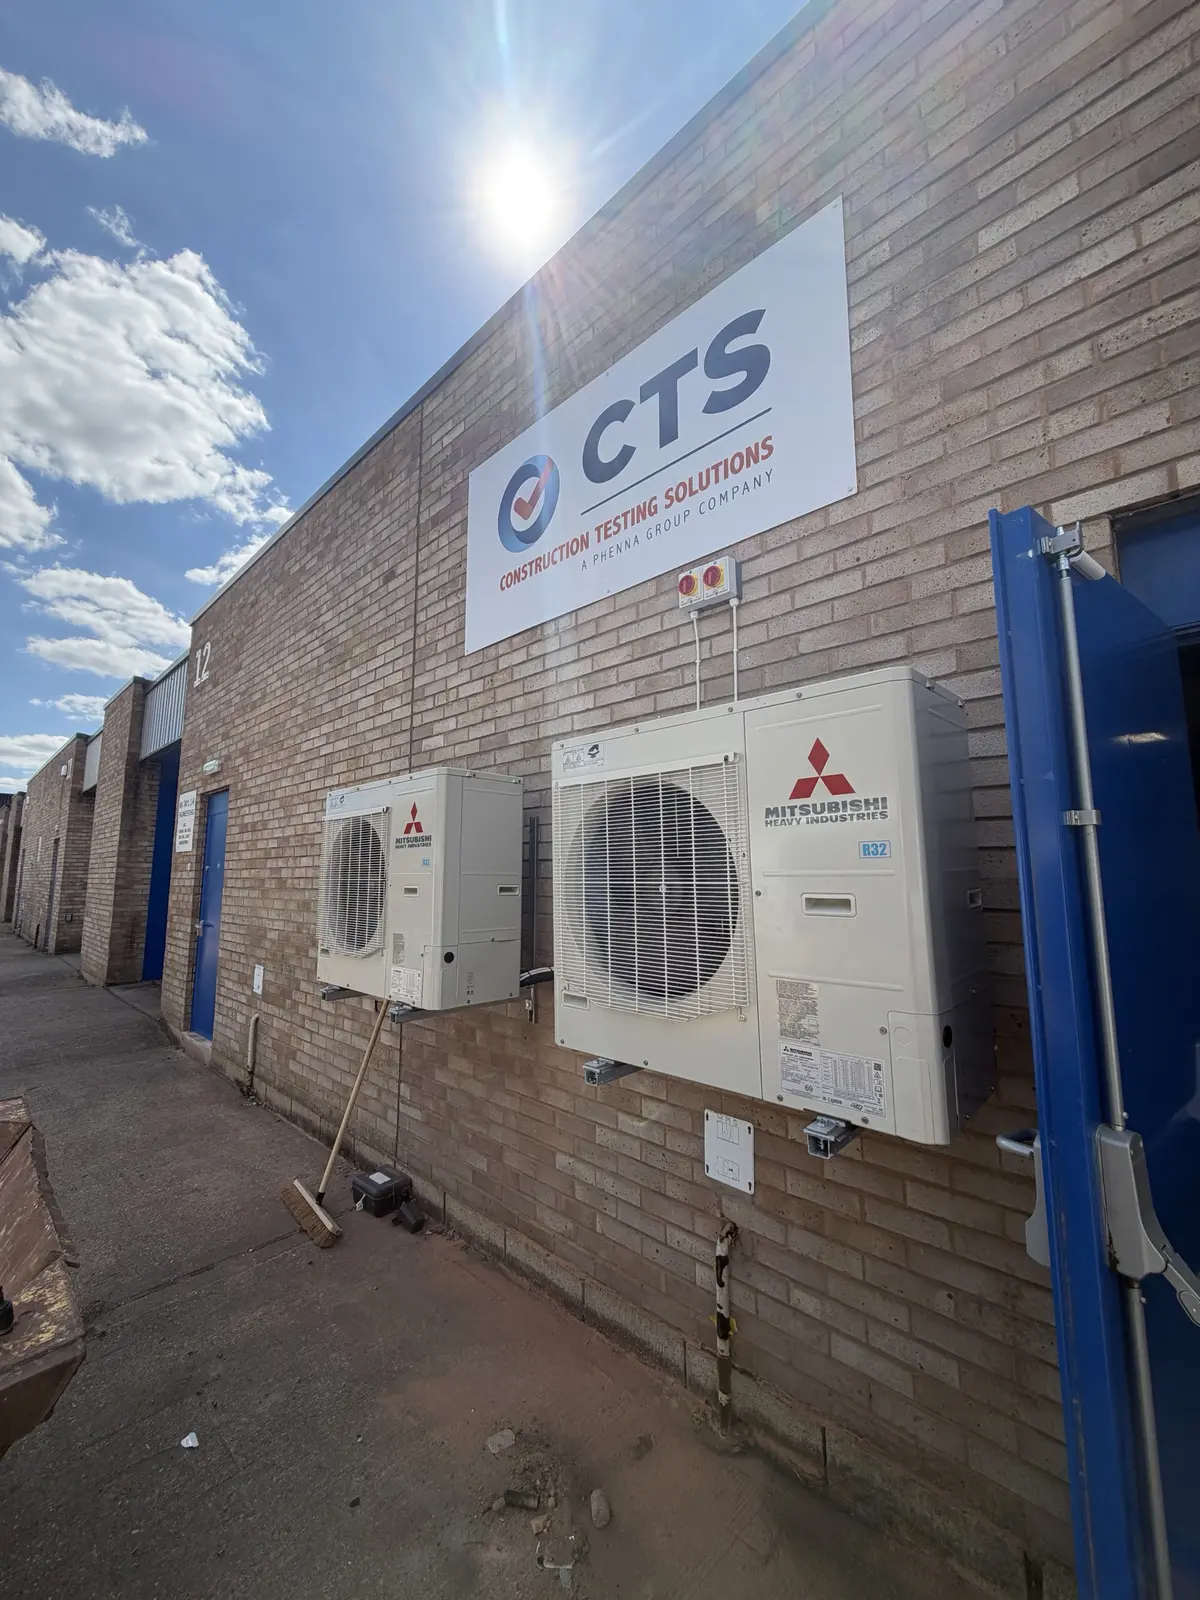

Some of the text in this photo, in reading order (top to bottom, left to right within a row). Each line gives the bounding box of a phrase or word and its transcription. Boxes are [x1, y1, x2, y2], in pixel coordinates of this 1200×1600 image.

[582, 309, 771, 484] CTS
[500, 435, 775, 592] CONSTRUCTION TESTING SOLUTIONS
[581, 468, 773, 572] A PHENNA GROUP COMPANY
[193, 641, 211, 688] 12
[764, 796, 889, 819] MITSUBISHI
[764, 811, 889, 828] HEAVY INDUSTRIES
[395, 834, 432, 845] MITSUBISHI
[862, 842, 888, 857] R32
